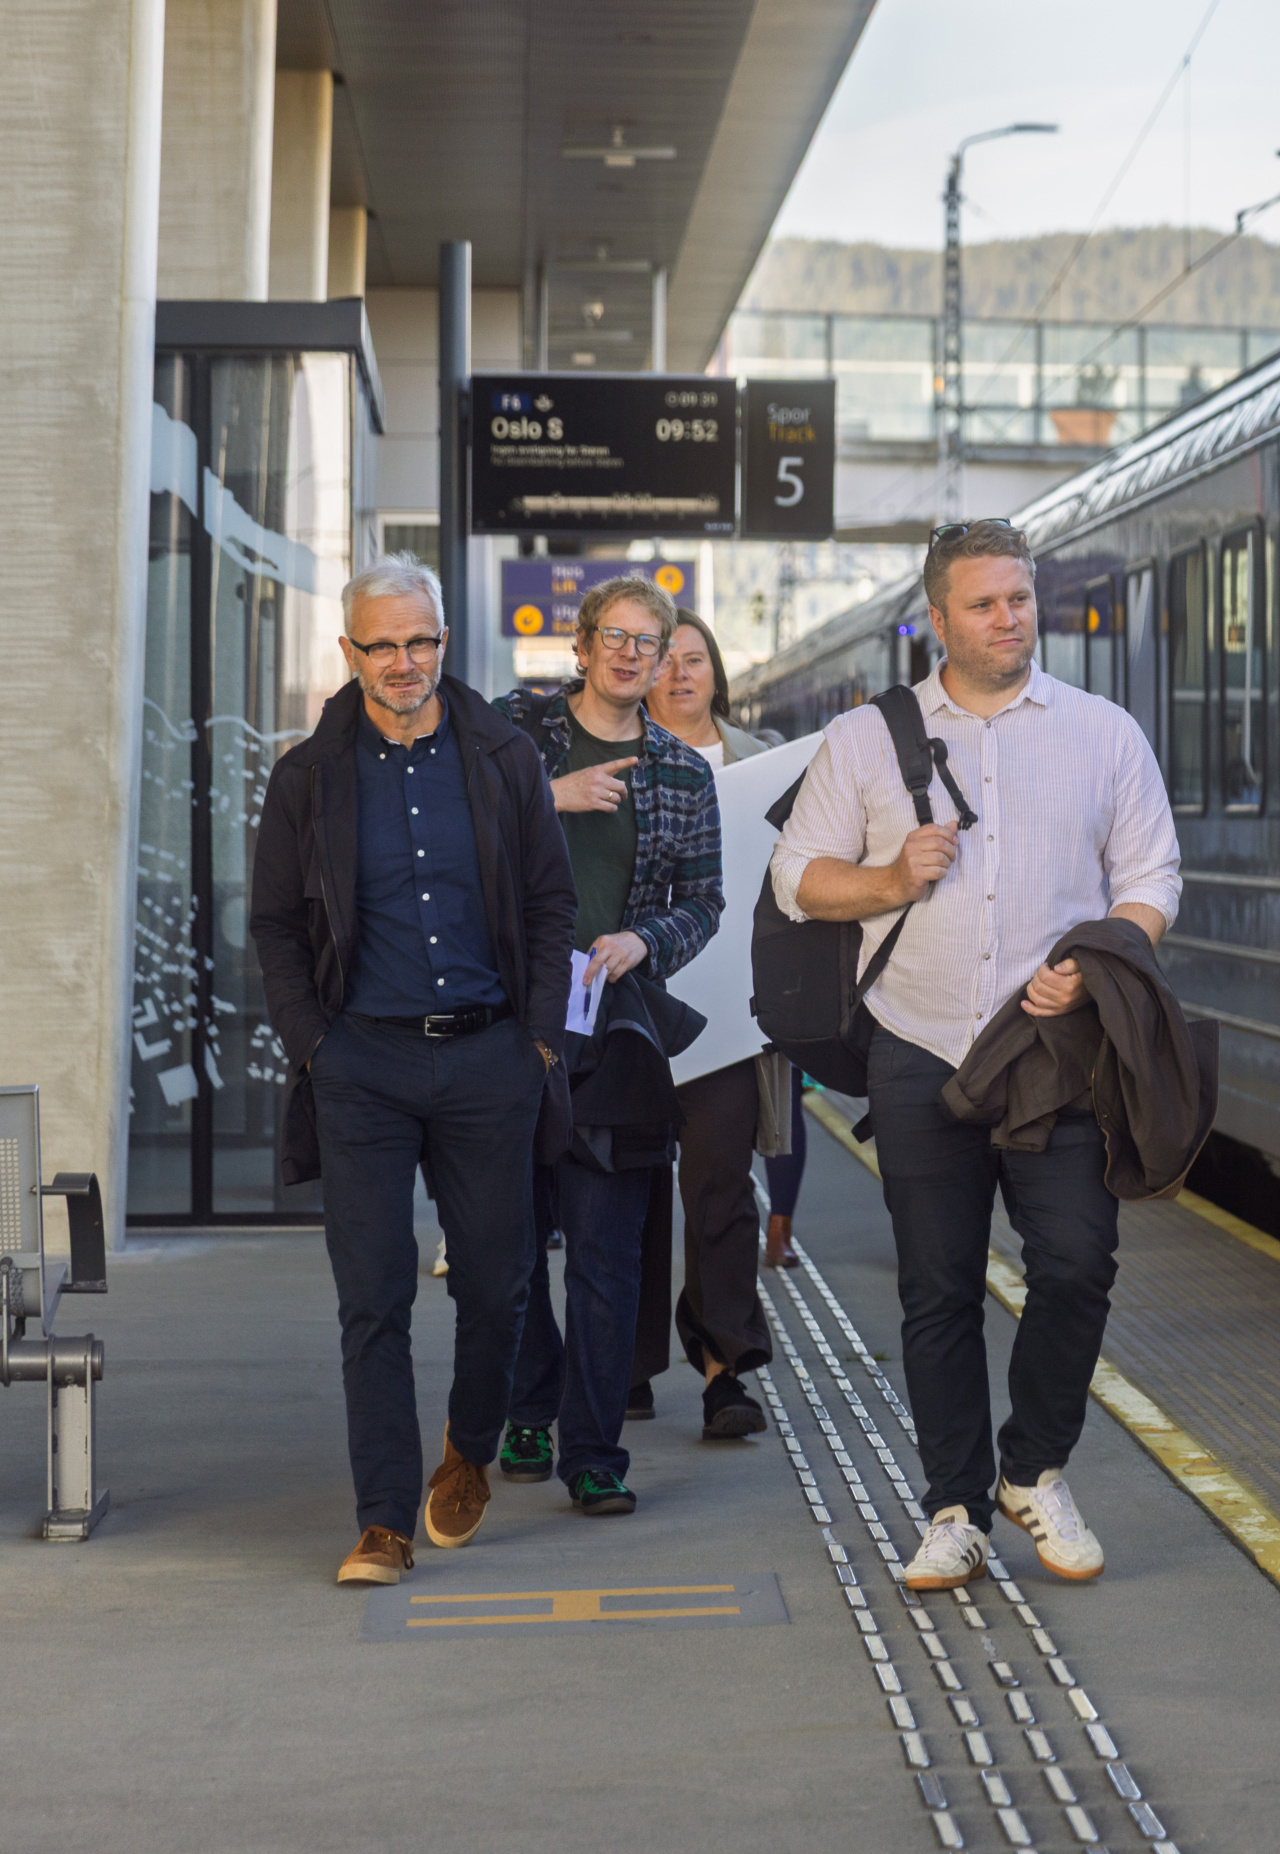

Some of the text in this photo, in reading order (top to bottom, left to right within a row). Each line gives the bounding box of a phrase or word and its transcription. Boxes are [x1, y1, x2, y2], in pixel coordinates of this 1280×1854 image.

[767, 402, 812, 426] Spor
[490, 416, 564, 440] Oslo S
[656, 418, 719, 442] 09:52
[768, 422, 817, 443] Track
[774, 456, 805, 507] 5
